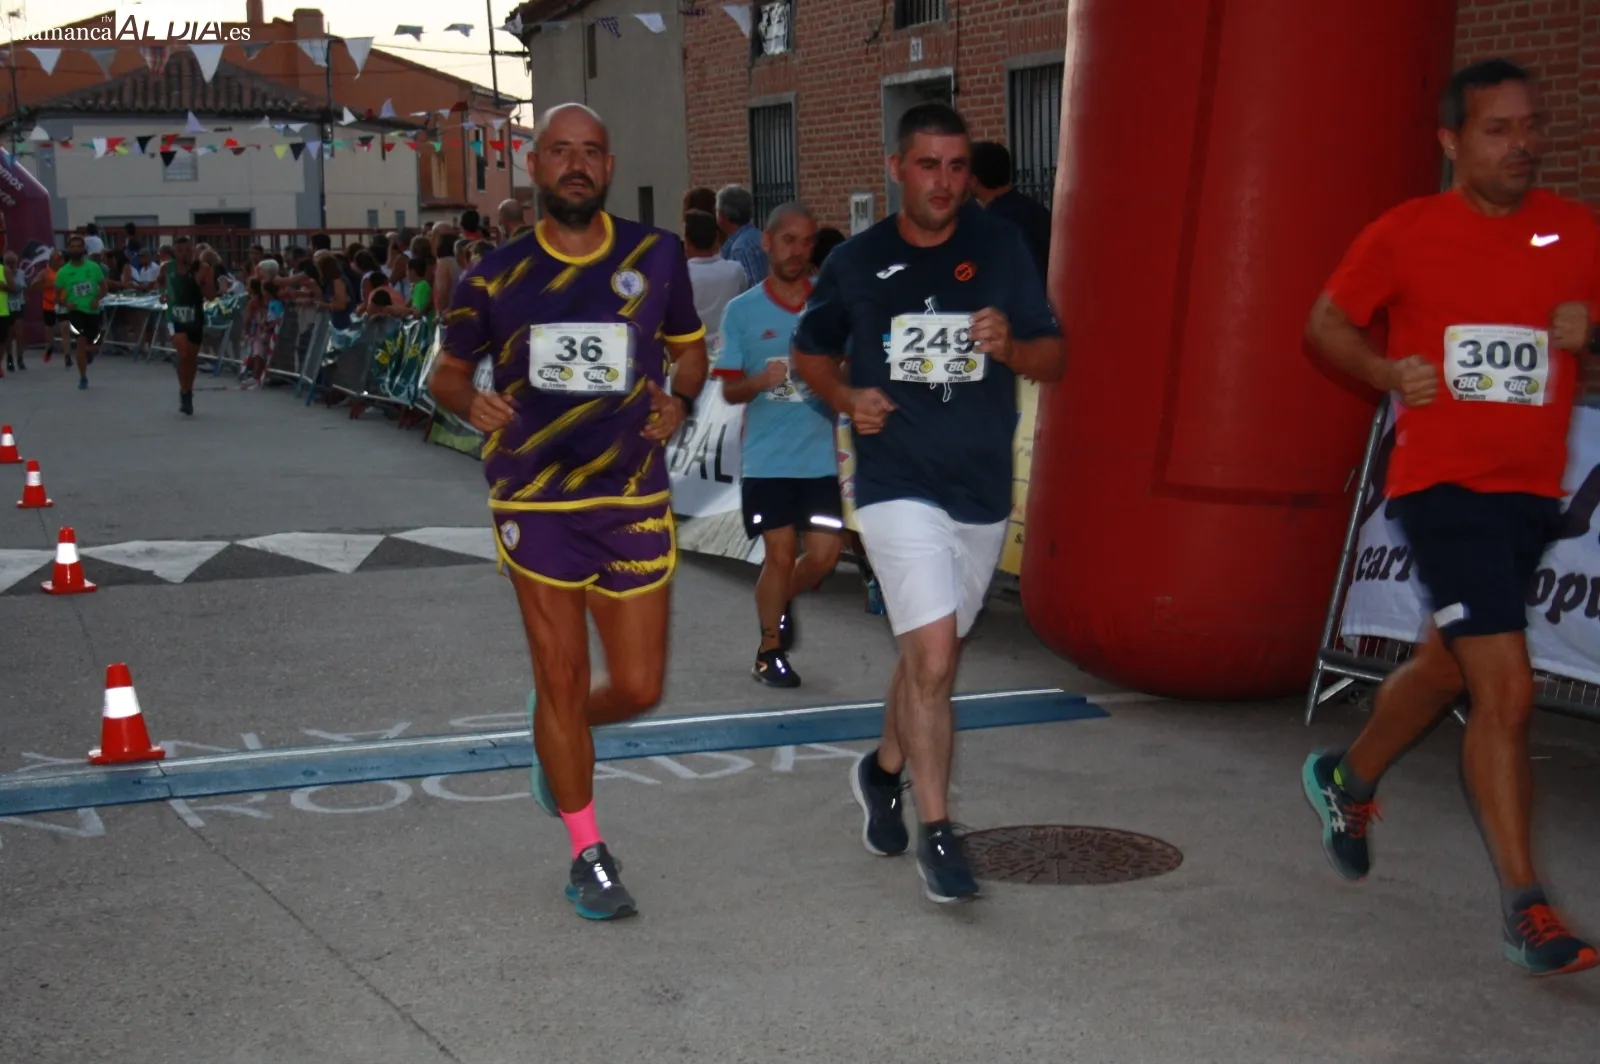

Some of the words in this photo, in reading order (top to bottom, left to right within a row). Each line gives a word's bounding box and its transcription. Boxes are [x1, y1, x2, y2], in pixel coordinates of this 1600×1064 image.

[554, 335, 603, 362] 36
[902, 327, 975, 354] 249
[1457, 340, 1537, 372] 300
